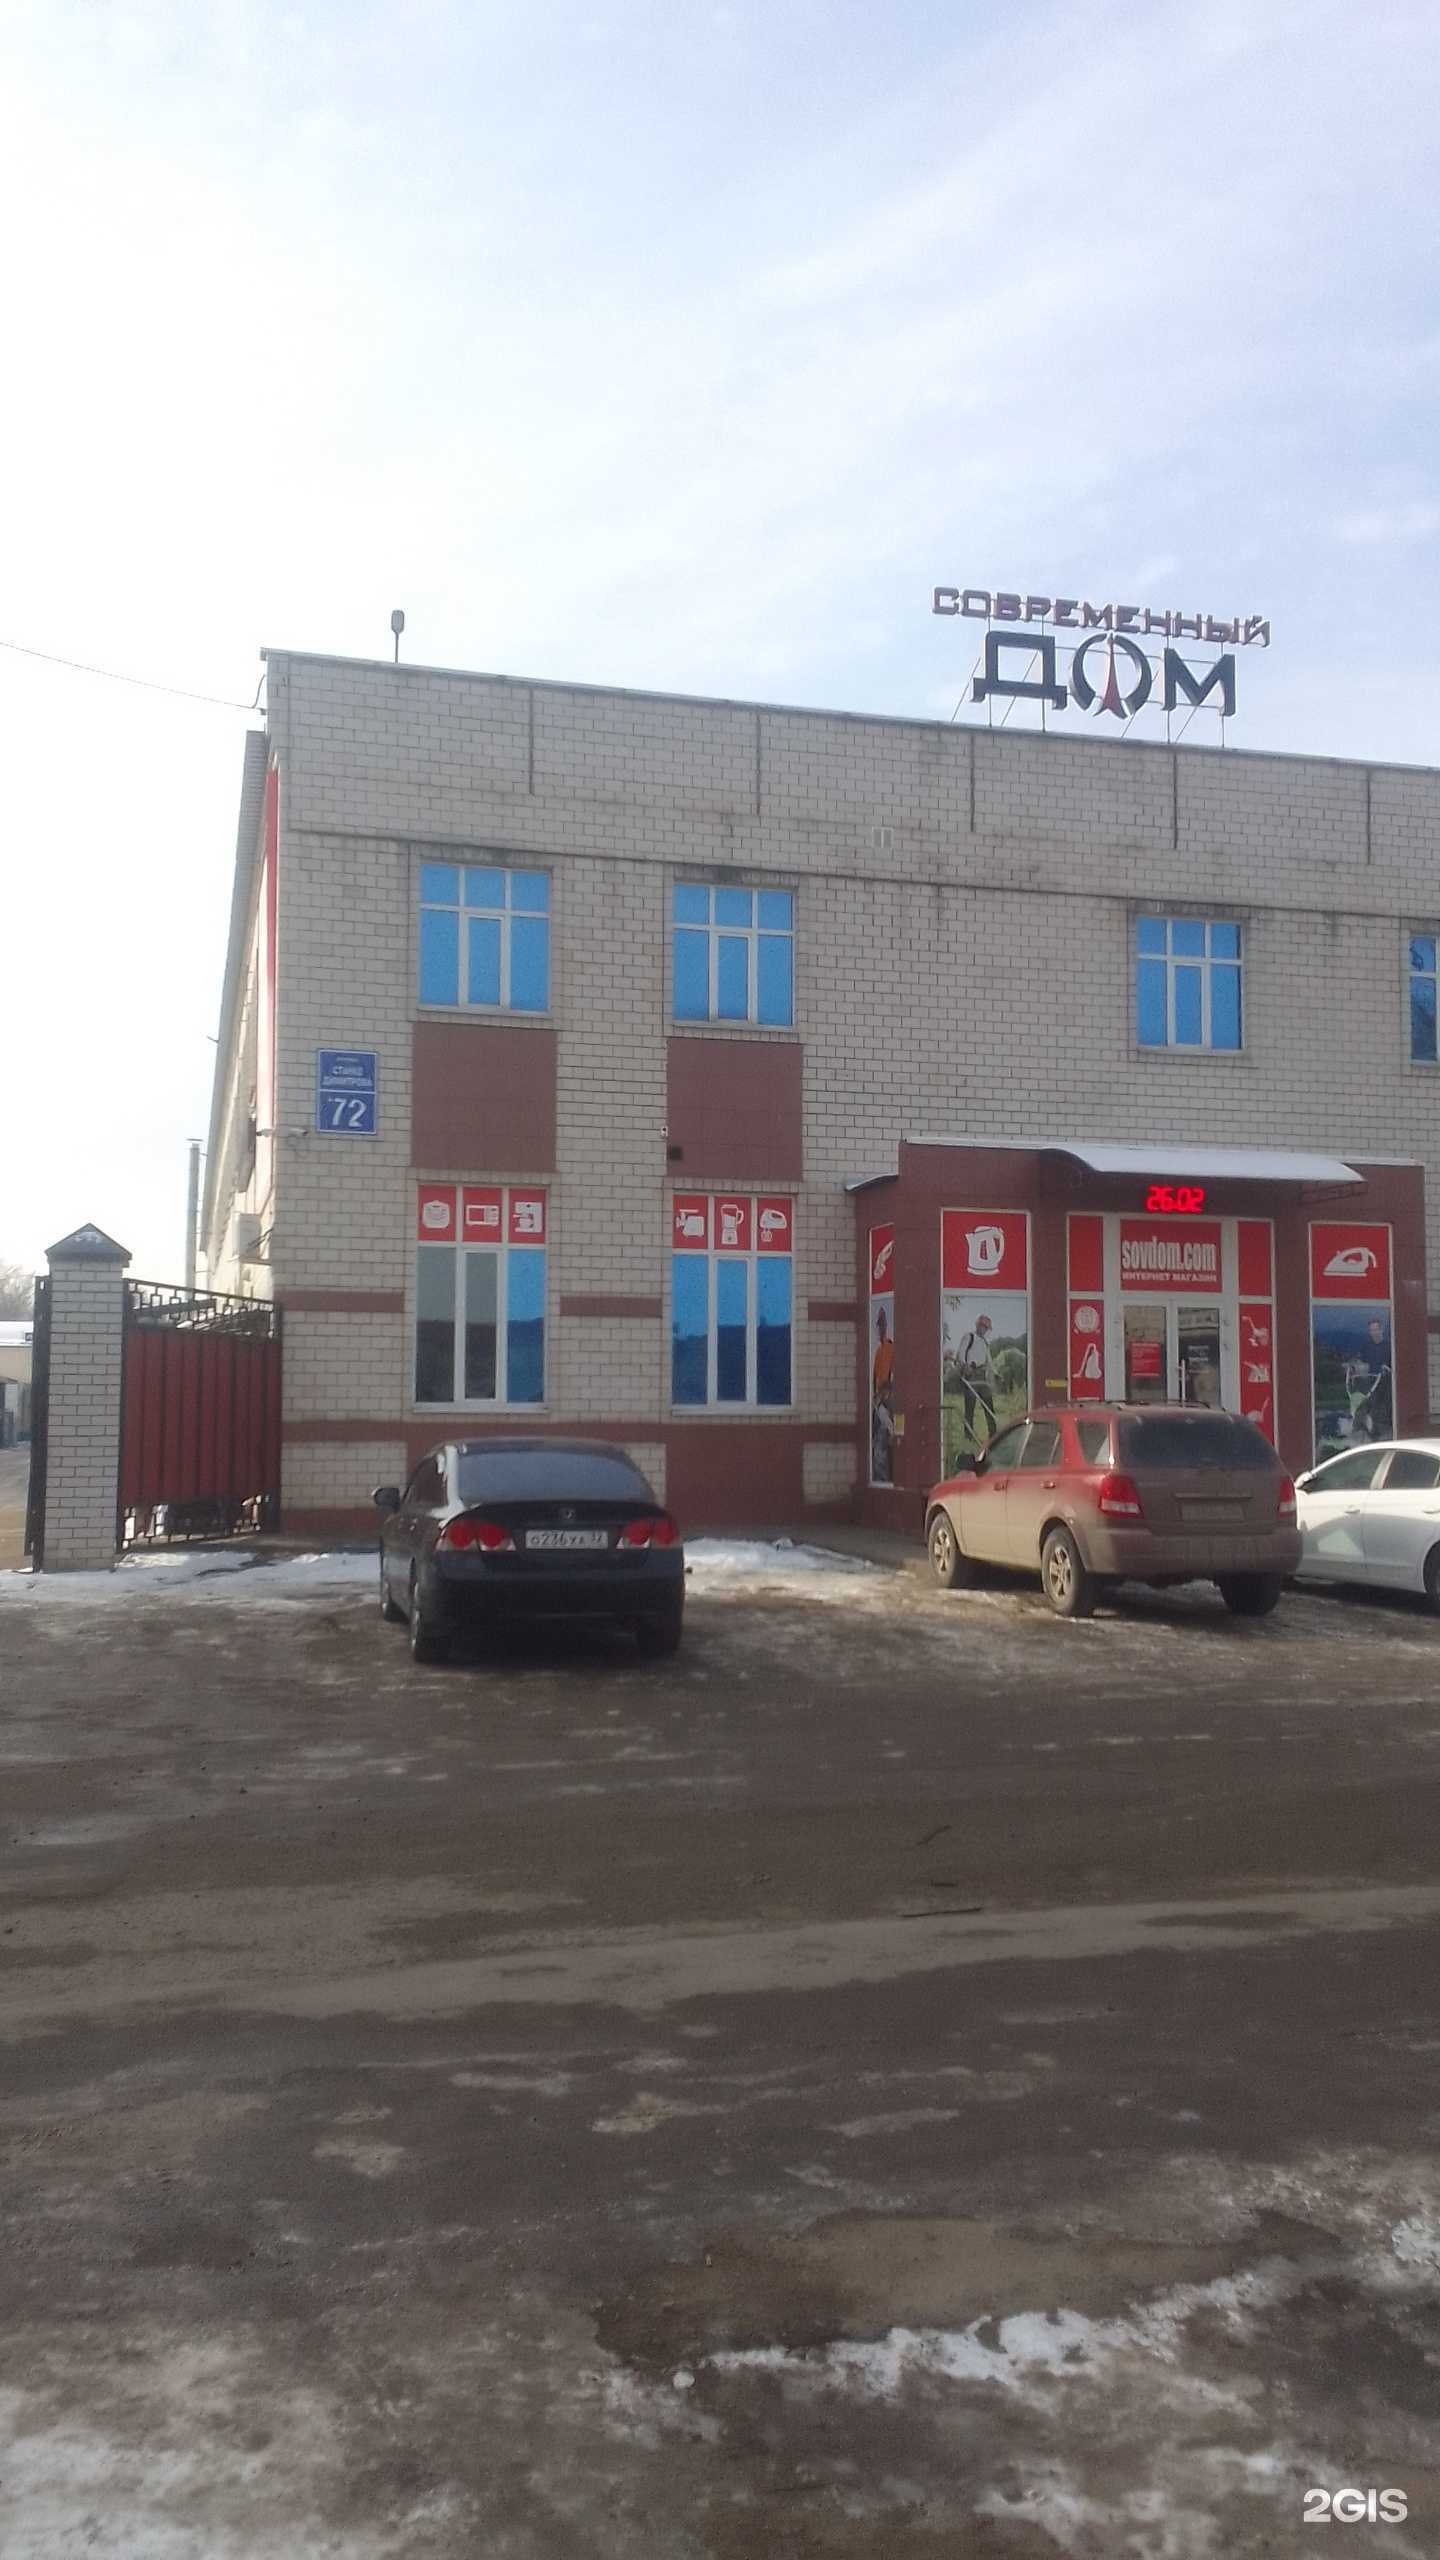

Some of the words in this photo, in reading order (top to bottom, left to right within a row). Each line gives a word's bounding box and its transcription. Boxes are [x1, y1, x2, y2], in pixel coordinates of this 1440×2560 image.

[932, 586, 1271, 648] СОВРЕМЕННЫЙ
[970, 630, 1236, 719] ДОМ
[331, 1097, 367, 1128] 72
[1121, 1235, 1217, 1272] sovdom.com
